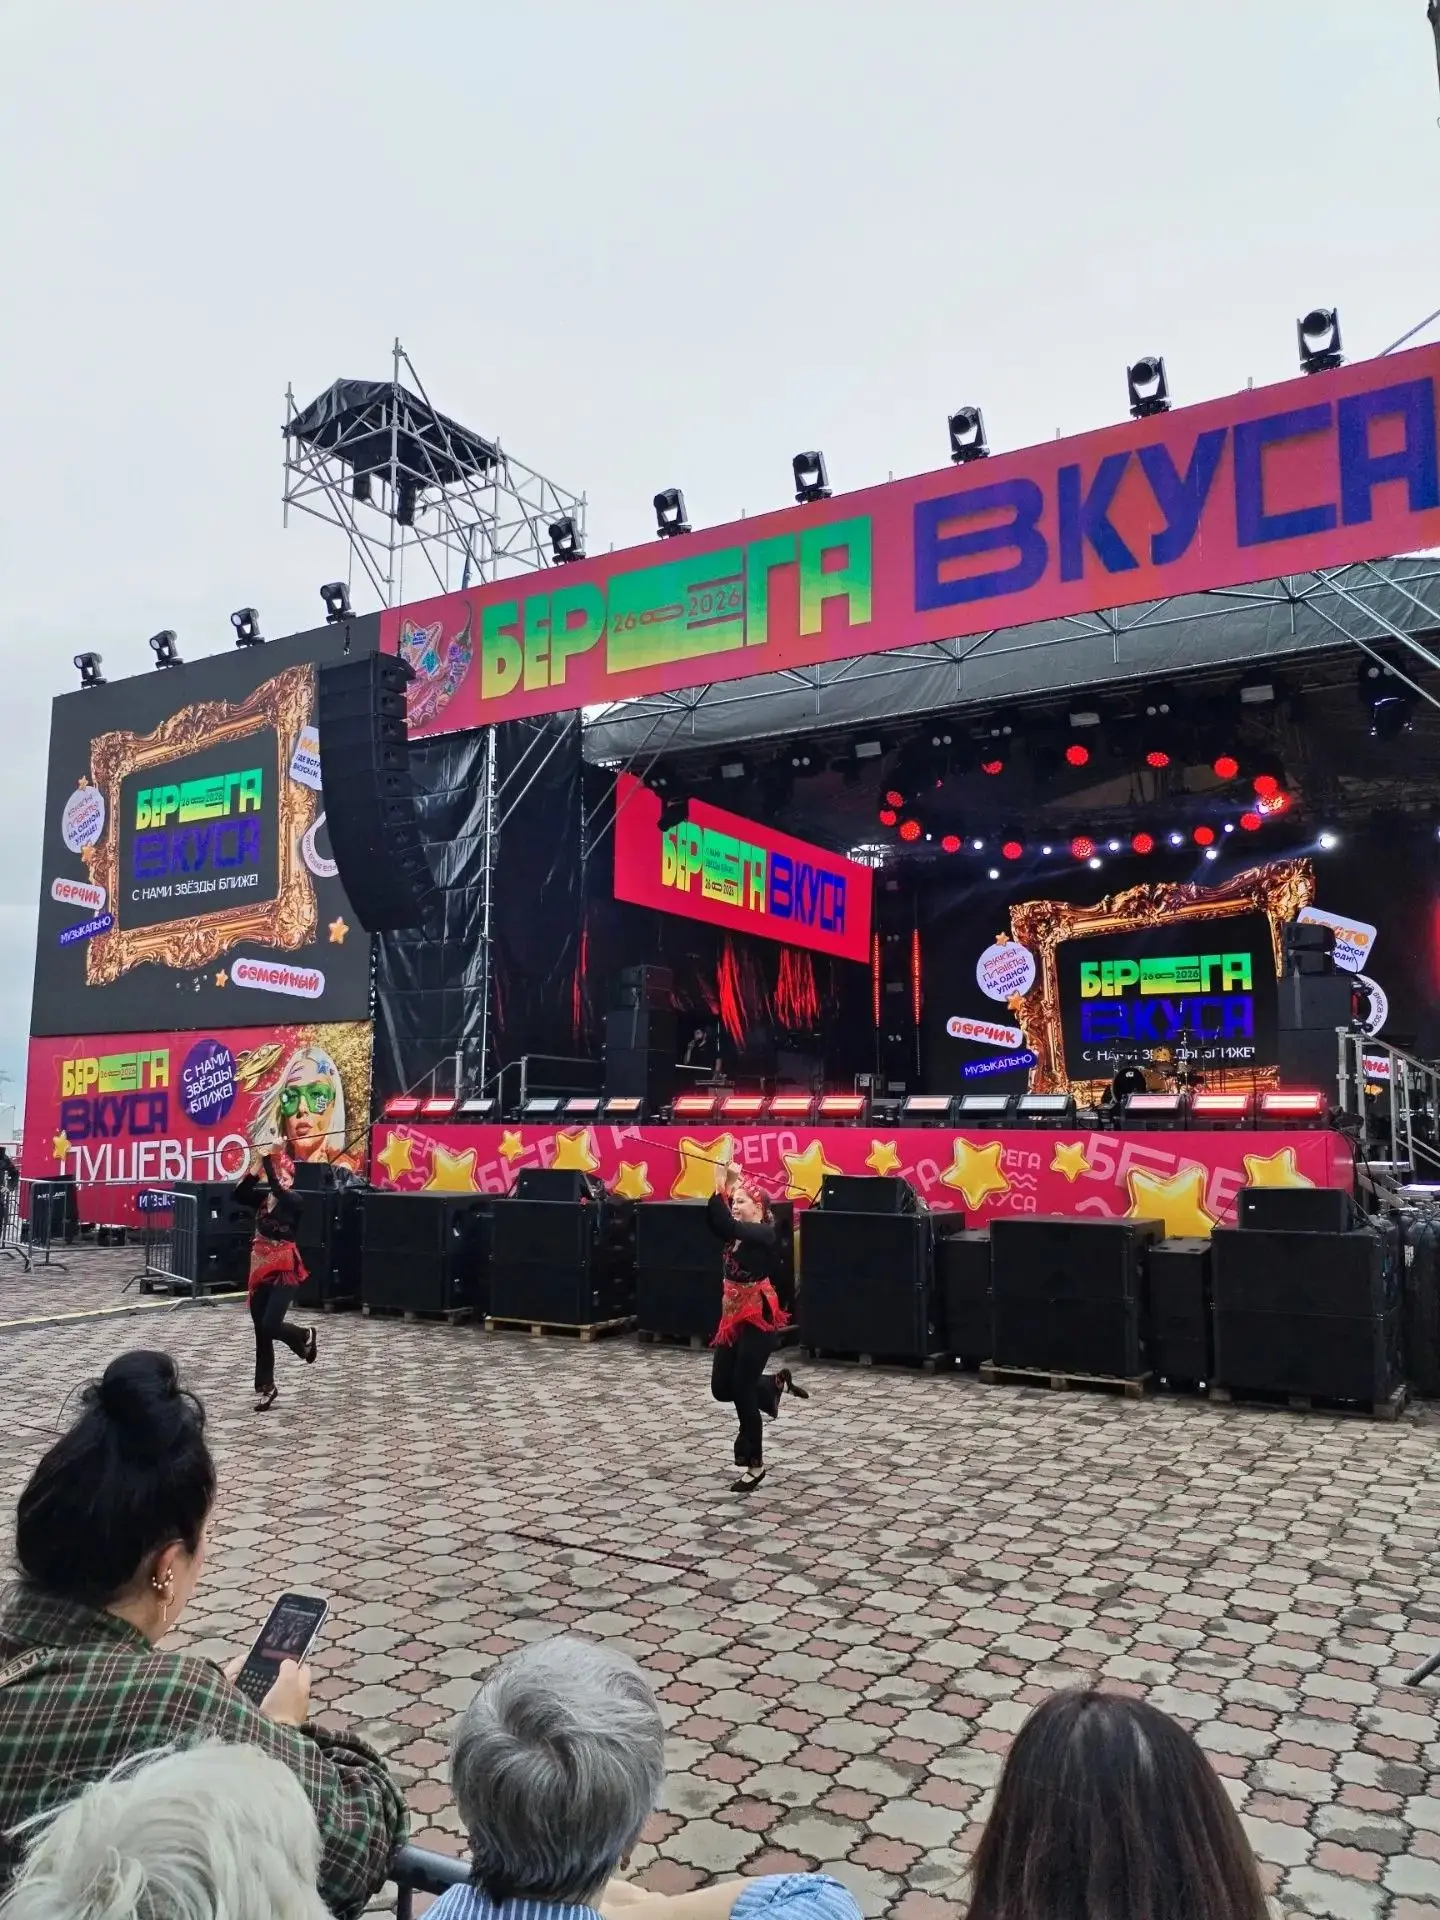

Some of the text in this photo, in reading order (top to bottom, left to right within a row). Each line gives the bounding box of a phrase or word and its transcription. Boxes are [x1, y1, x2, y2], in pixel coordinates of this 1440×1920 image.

[481, 377, 1440, 700] БЕРЕГА ВКУСА
[613, 588, 740, 633] 26 2026
[136, 768, 262, 830] БЕРЕГА
[133, 817, 261, 880] ВКУСА
[132, 874, 259, 901] С НАМИ ЗВЁЗДЫ БЛИЖЕ!
[662, 821, 847, 936] БЕРЕГА ВКУСА
[60, 916, 111, 945] МУЗЫКАЛЬНО
[986, 963, 1030, 990] НА ОДНОЙ
[996, 976, 1027, 994] УЛИЦЕ!
[1081, 953, 1253, 998] БЕРЕГА
[1175, 970, 1200, 980] 2026
[1081, 996, 1255, 1042] ВКУСА
[62, 1048, 169, 1097] БЕРЕГА
[183, 1050, 230, 1082] С НАМИ
[186, 1065, 232, 1099] ЗВЁЗДЫ
[964, 1053, 1033, 1076] МУЗЫКАЛЬНО
[61, 1092, 168, 1140] ВКУСА
[190, 1083, 233, 1114] БЛИЖЕ!
